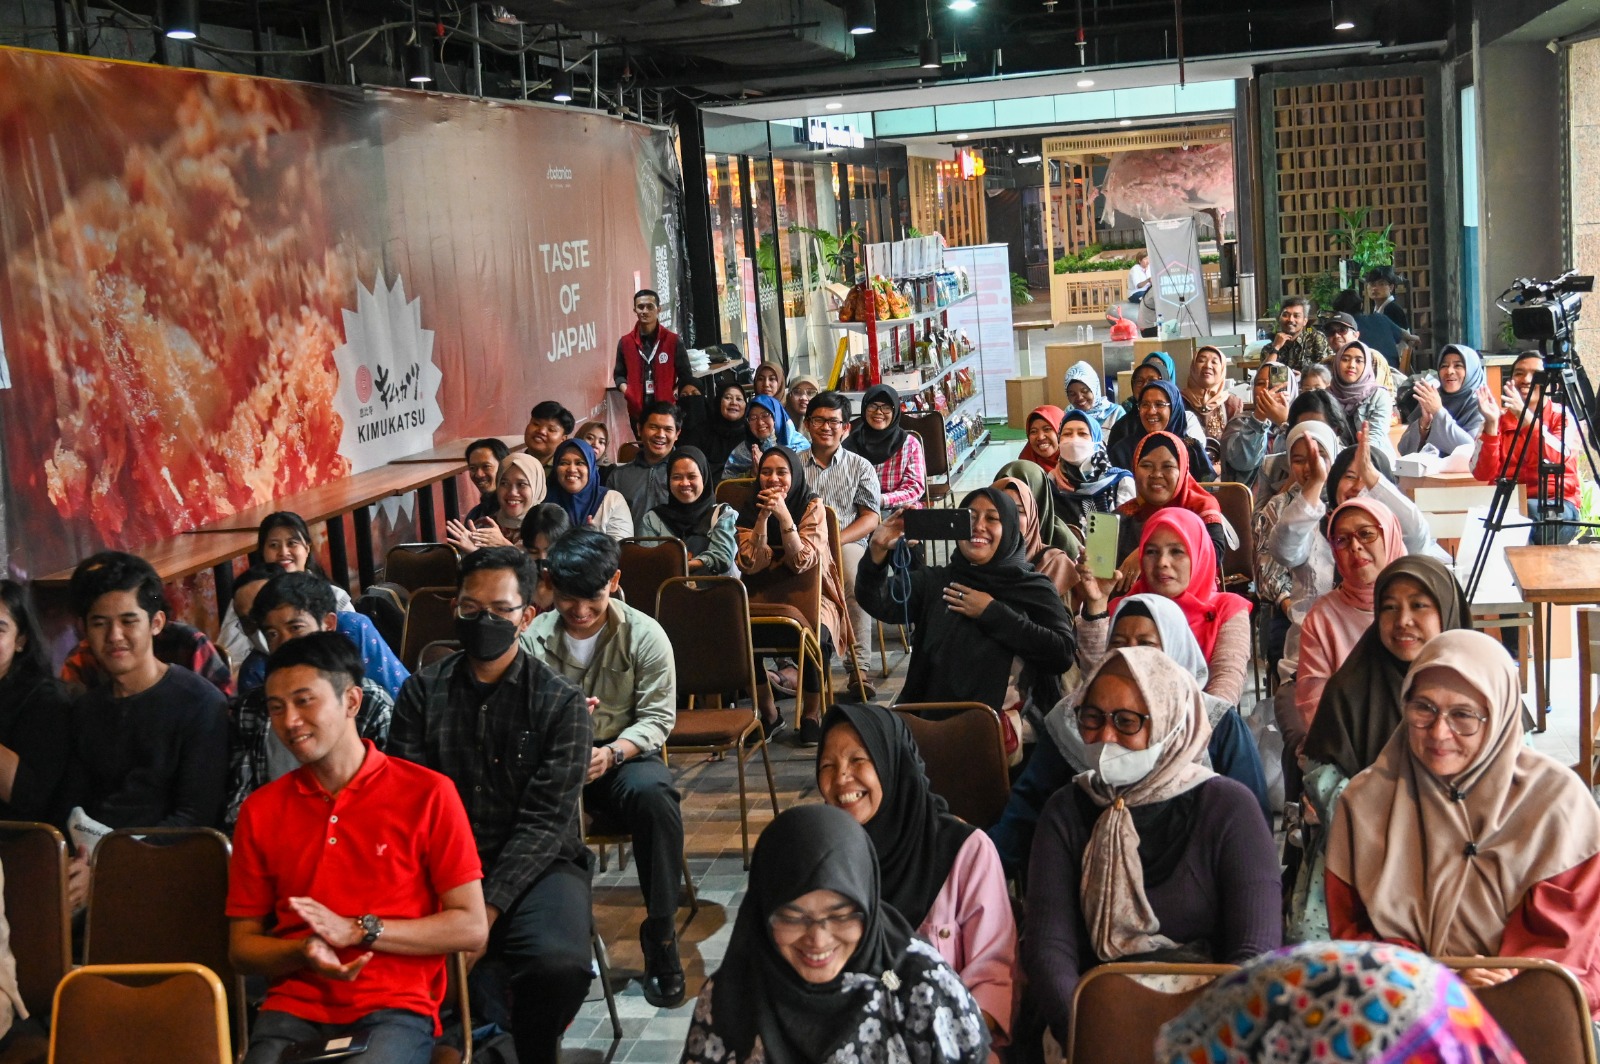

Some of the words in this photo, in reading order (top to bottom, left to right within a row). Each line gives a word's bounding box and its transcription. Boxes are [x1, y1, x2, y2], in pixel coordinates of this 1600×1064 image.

[539, 240, 590, 273] TASTE
[560, 283, 580, 315] OF
[547, 321, 597, 363] JAPAN
[357, 408, 426, 444] KIMUKATSU
